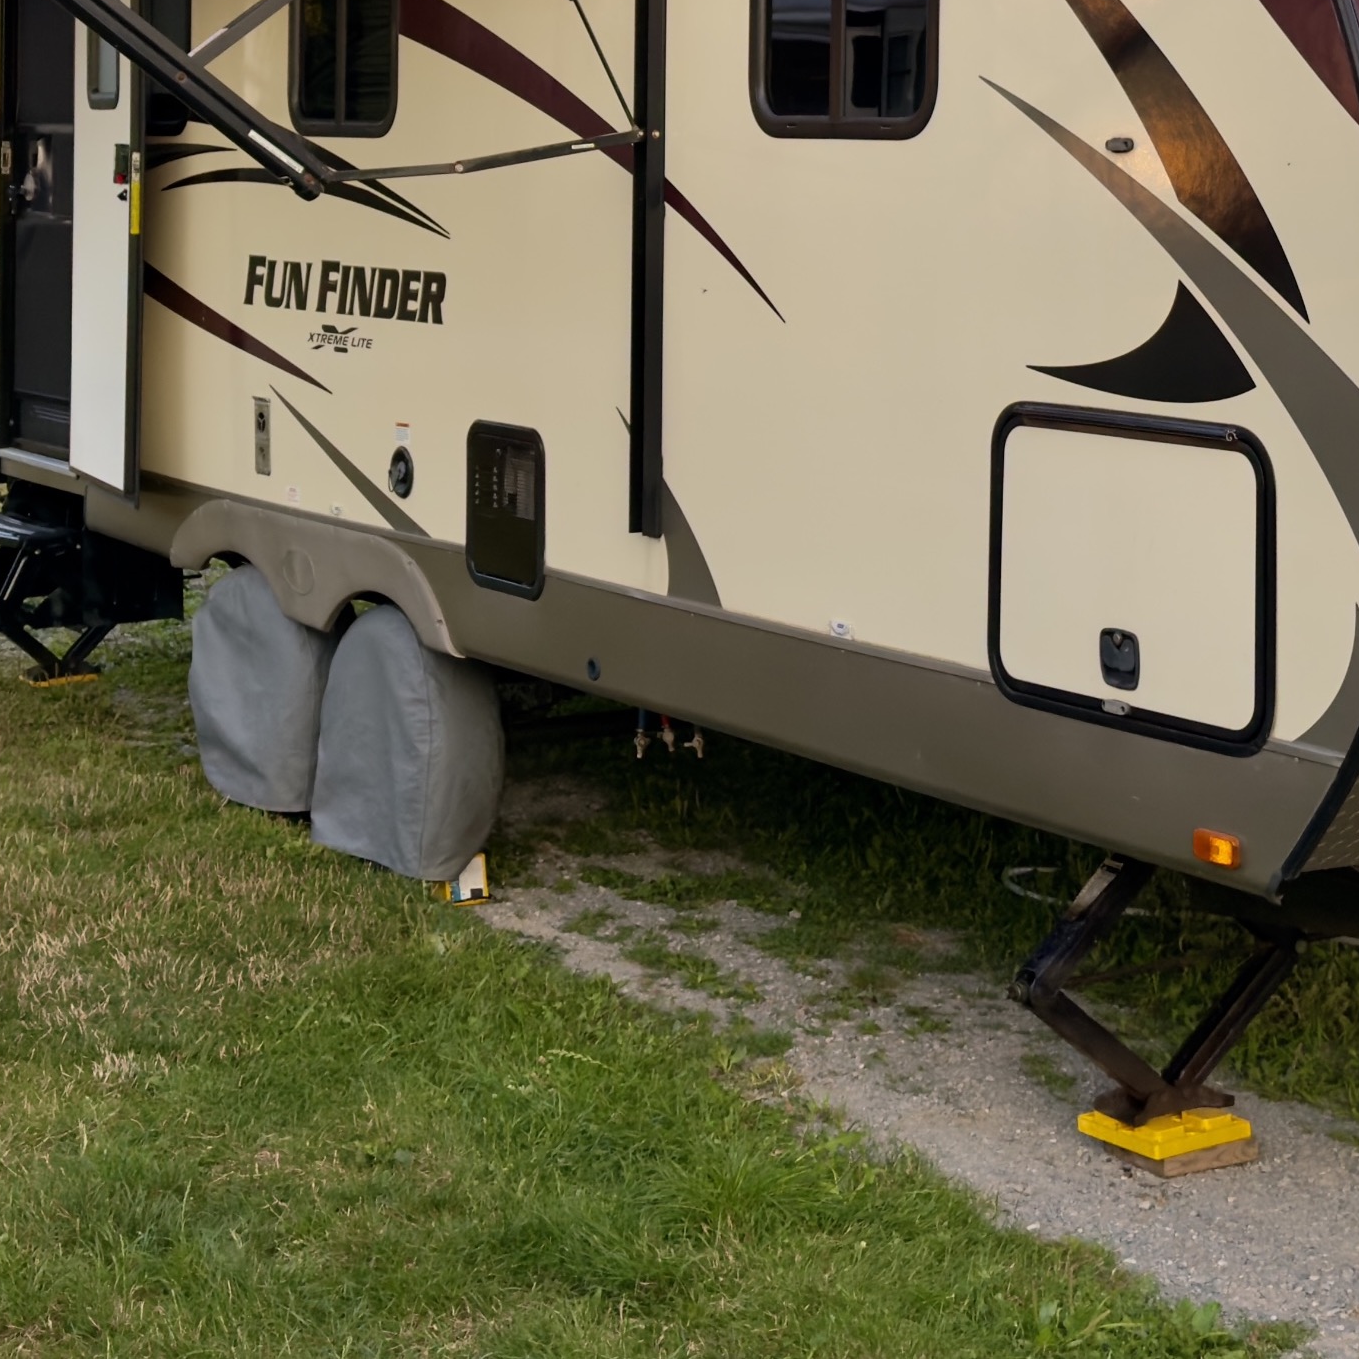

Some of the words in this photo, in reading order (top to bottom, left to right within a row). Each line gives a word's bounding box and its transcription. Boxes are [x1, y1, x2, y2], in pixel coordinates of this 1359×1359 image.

[243, 254, 313, 311] FUN
[315, 259, 447, 325] FINDER
[307, 332, 350, 346] XTREME
[351, 337, 373, 349] LITE
